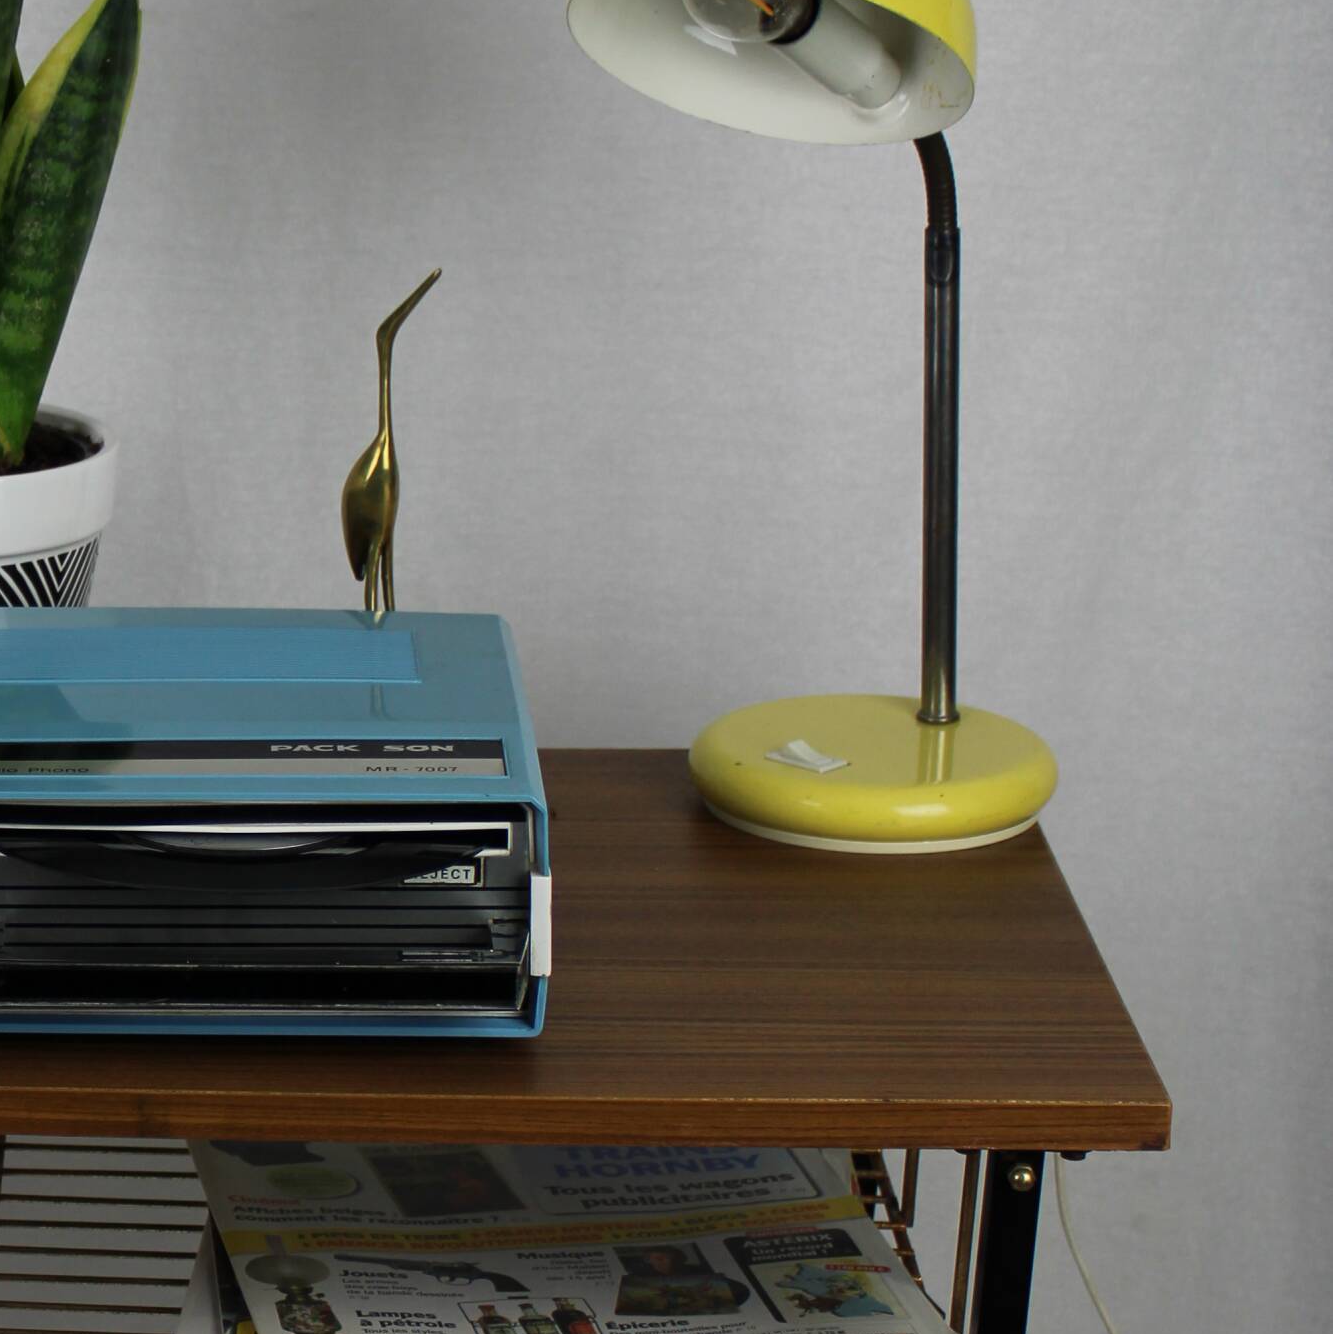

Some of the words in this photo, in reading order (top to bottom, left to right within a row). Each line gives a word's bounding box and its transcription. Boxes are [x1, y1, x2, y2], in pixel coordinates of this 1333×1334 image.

[270, 744, 361, 753] PACK
[383, 744, 456, 753] SON
[27, 766, 89, 774] Phono
[410, 869, 471, 879] JECT
[553, 1155, 759, 1178] HORNBY
[543, 1184, 616, 1196] Tous
[624, 1183, 669, 1193] les
[679, 1173, 795, 1191] wagons
[581, 1187, 770, 1210] publicitaires
[516, 1251, 604, 1260] Musique
[339, 1269, 408, 1279] Jouets
[355, 1310, 437, 1319] Lampes
[379, 1319, 457, 1328] pétrole
